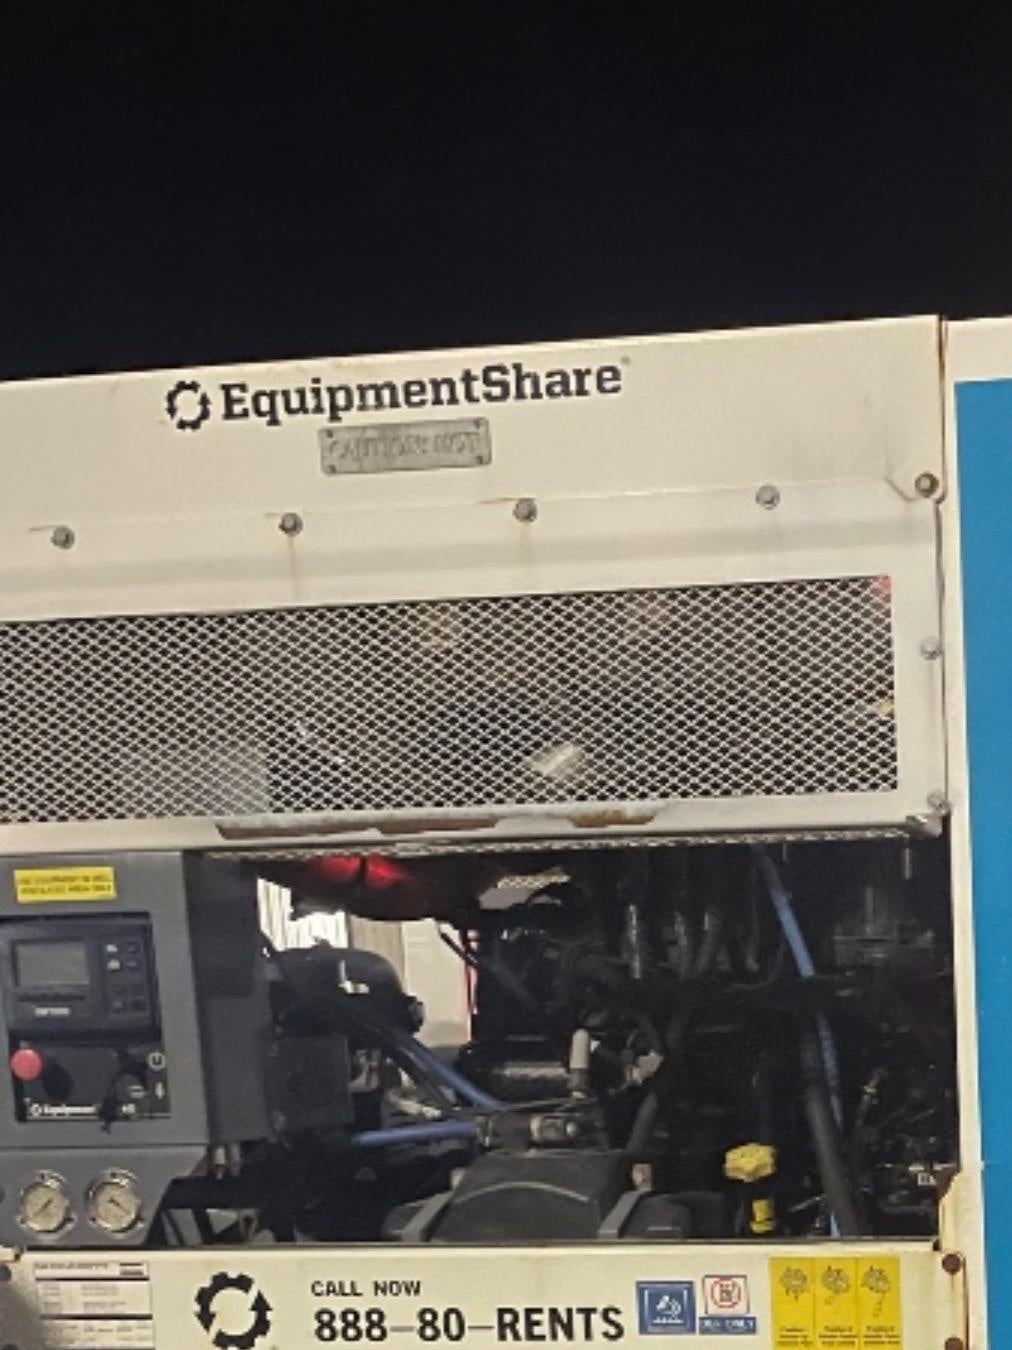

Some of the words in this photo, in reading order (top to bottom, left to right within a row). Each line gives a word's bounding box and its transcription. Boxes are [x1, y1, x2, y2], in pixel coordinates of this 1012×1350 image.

[220, 363, 621, 426] EquipmentShare
[311, 1279, 363, 1297] CALL
[373, 1279, 422, 1297] NOW
